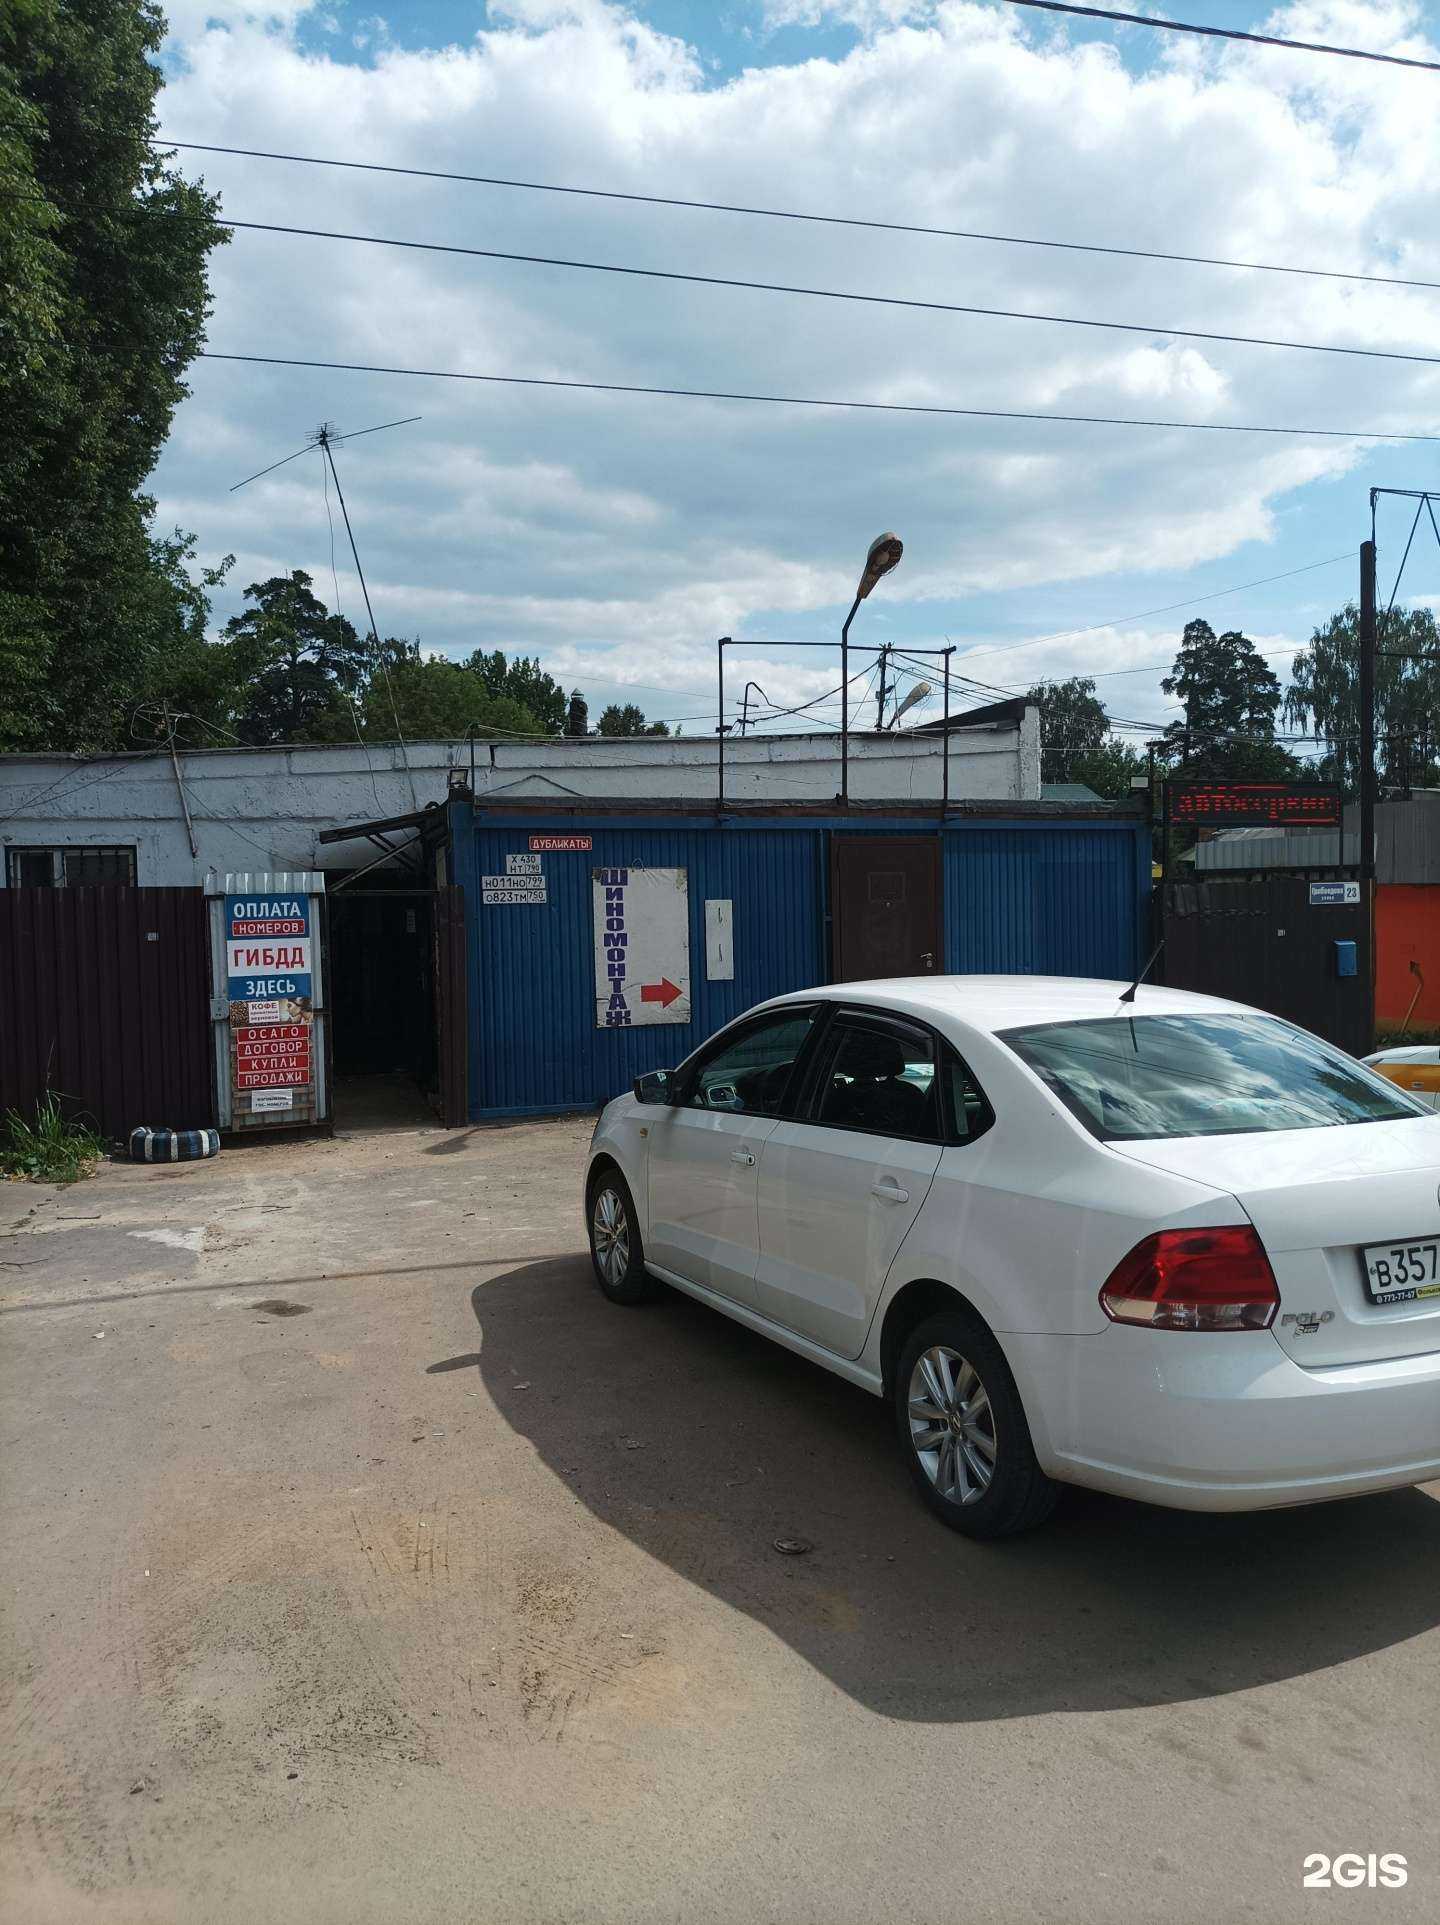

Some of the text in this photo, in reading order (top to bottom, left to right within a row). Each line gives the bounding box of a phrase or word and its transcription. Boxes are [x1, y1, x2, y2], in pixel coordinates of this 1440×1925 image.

[533, 839, 589, 849] ДУБЛИКАТЫ
[520, 855, 536, 863] 430
[510, 865, 523, 873] НТ
[528, 891, 544, 899] 750
[1346, 887, 1357, 898] 23
[233, 902, 301, 918] ОПЛАТА
[239, 922, 299, 934] НОМЕРОВ
[600, 869, 632, 1026] ШИНОМОНТАЖ
[233, 947, 304, 969] ГИБДД
[246, 980, 296, 997] ЗДЕСЬ
[251, 1003, 278, 1011] КОФЕ
[248, 1027, 299, 1039] ОСАГО
[244, 1041, 302, 1055] ДОГОВОР
[252, 1057, 297, 1070] КУПЛИ
[245, 1071, 302, 1086] ПРОДАЖИ
[1281, 1310, 1335, 1326] POLO
